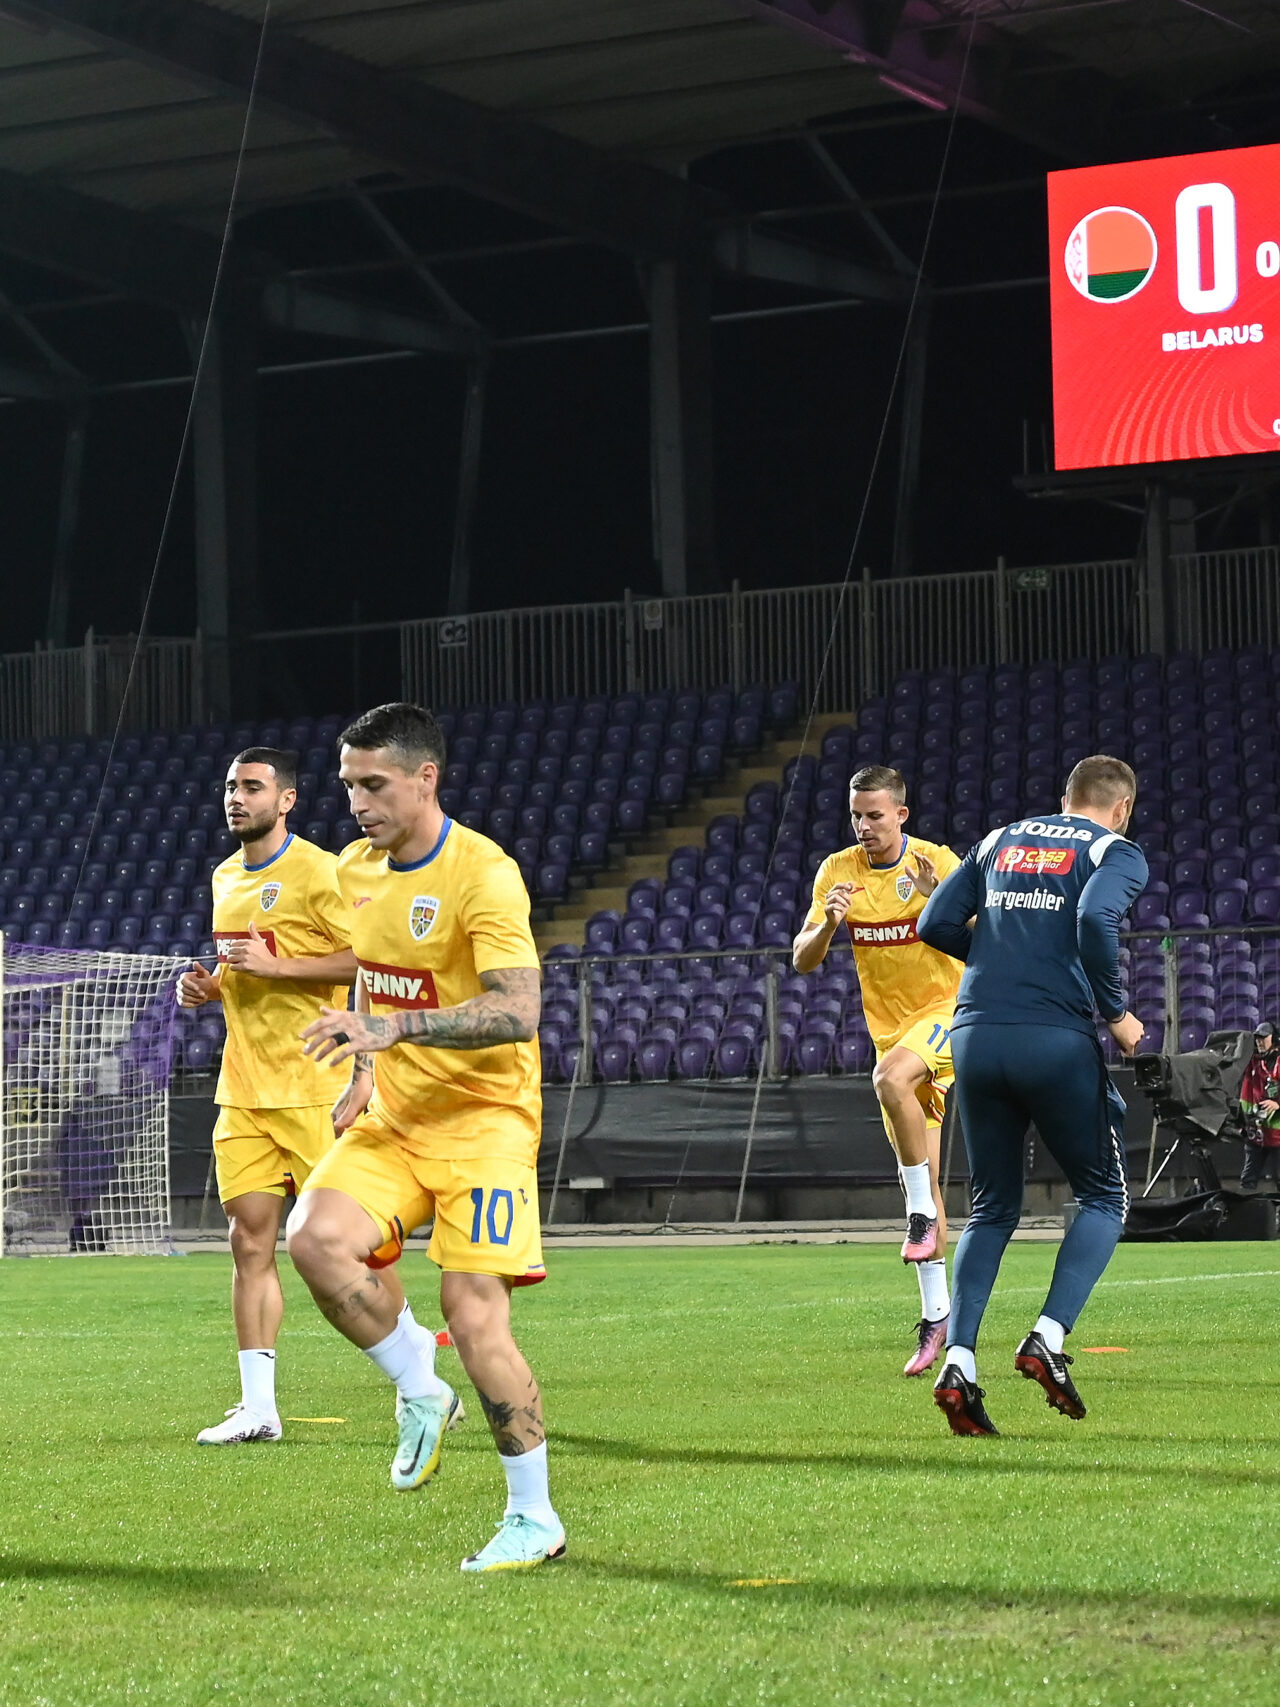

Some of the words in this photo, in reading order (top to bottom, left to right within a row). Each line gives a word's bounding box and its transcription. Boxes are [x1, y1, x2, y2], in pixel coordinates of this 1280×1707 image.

[1175, 182, 1239, 315] 0
[1161, 323, 1264, 352] BELARUS
[1025, 850, 1067, 863] casa
[984, 888, 1065, 912] Bergenbier
[361, 969, 428, 1001] ENNY.
[927, 1023, 950, 1054] 11
[470, 1187, 514, 1246] 10
